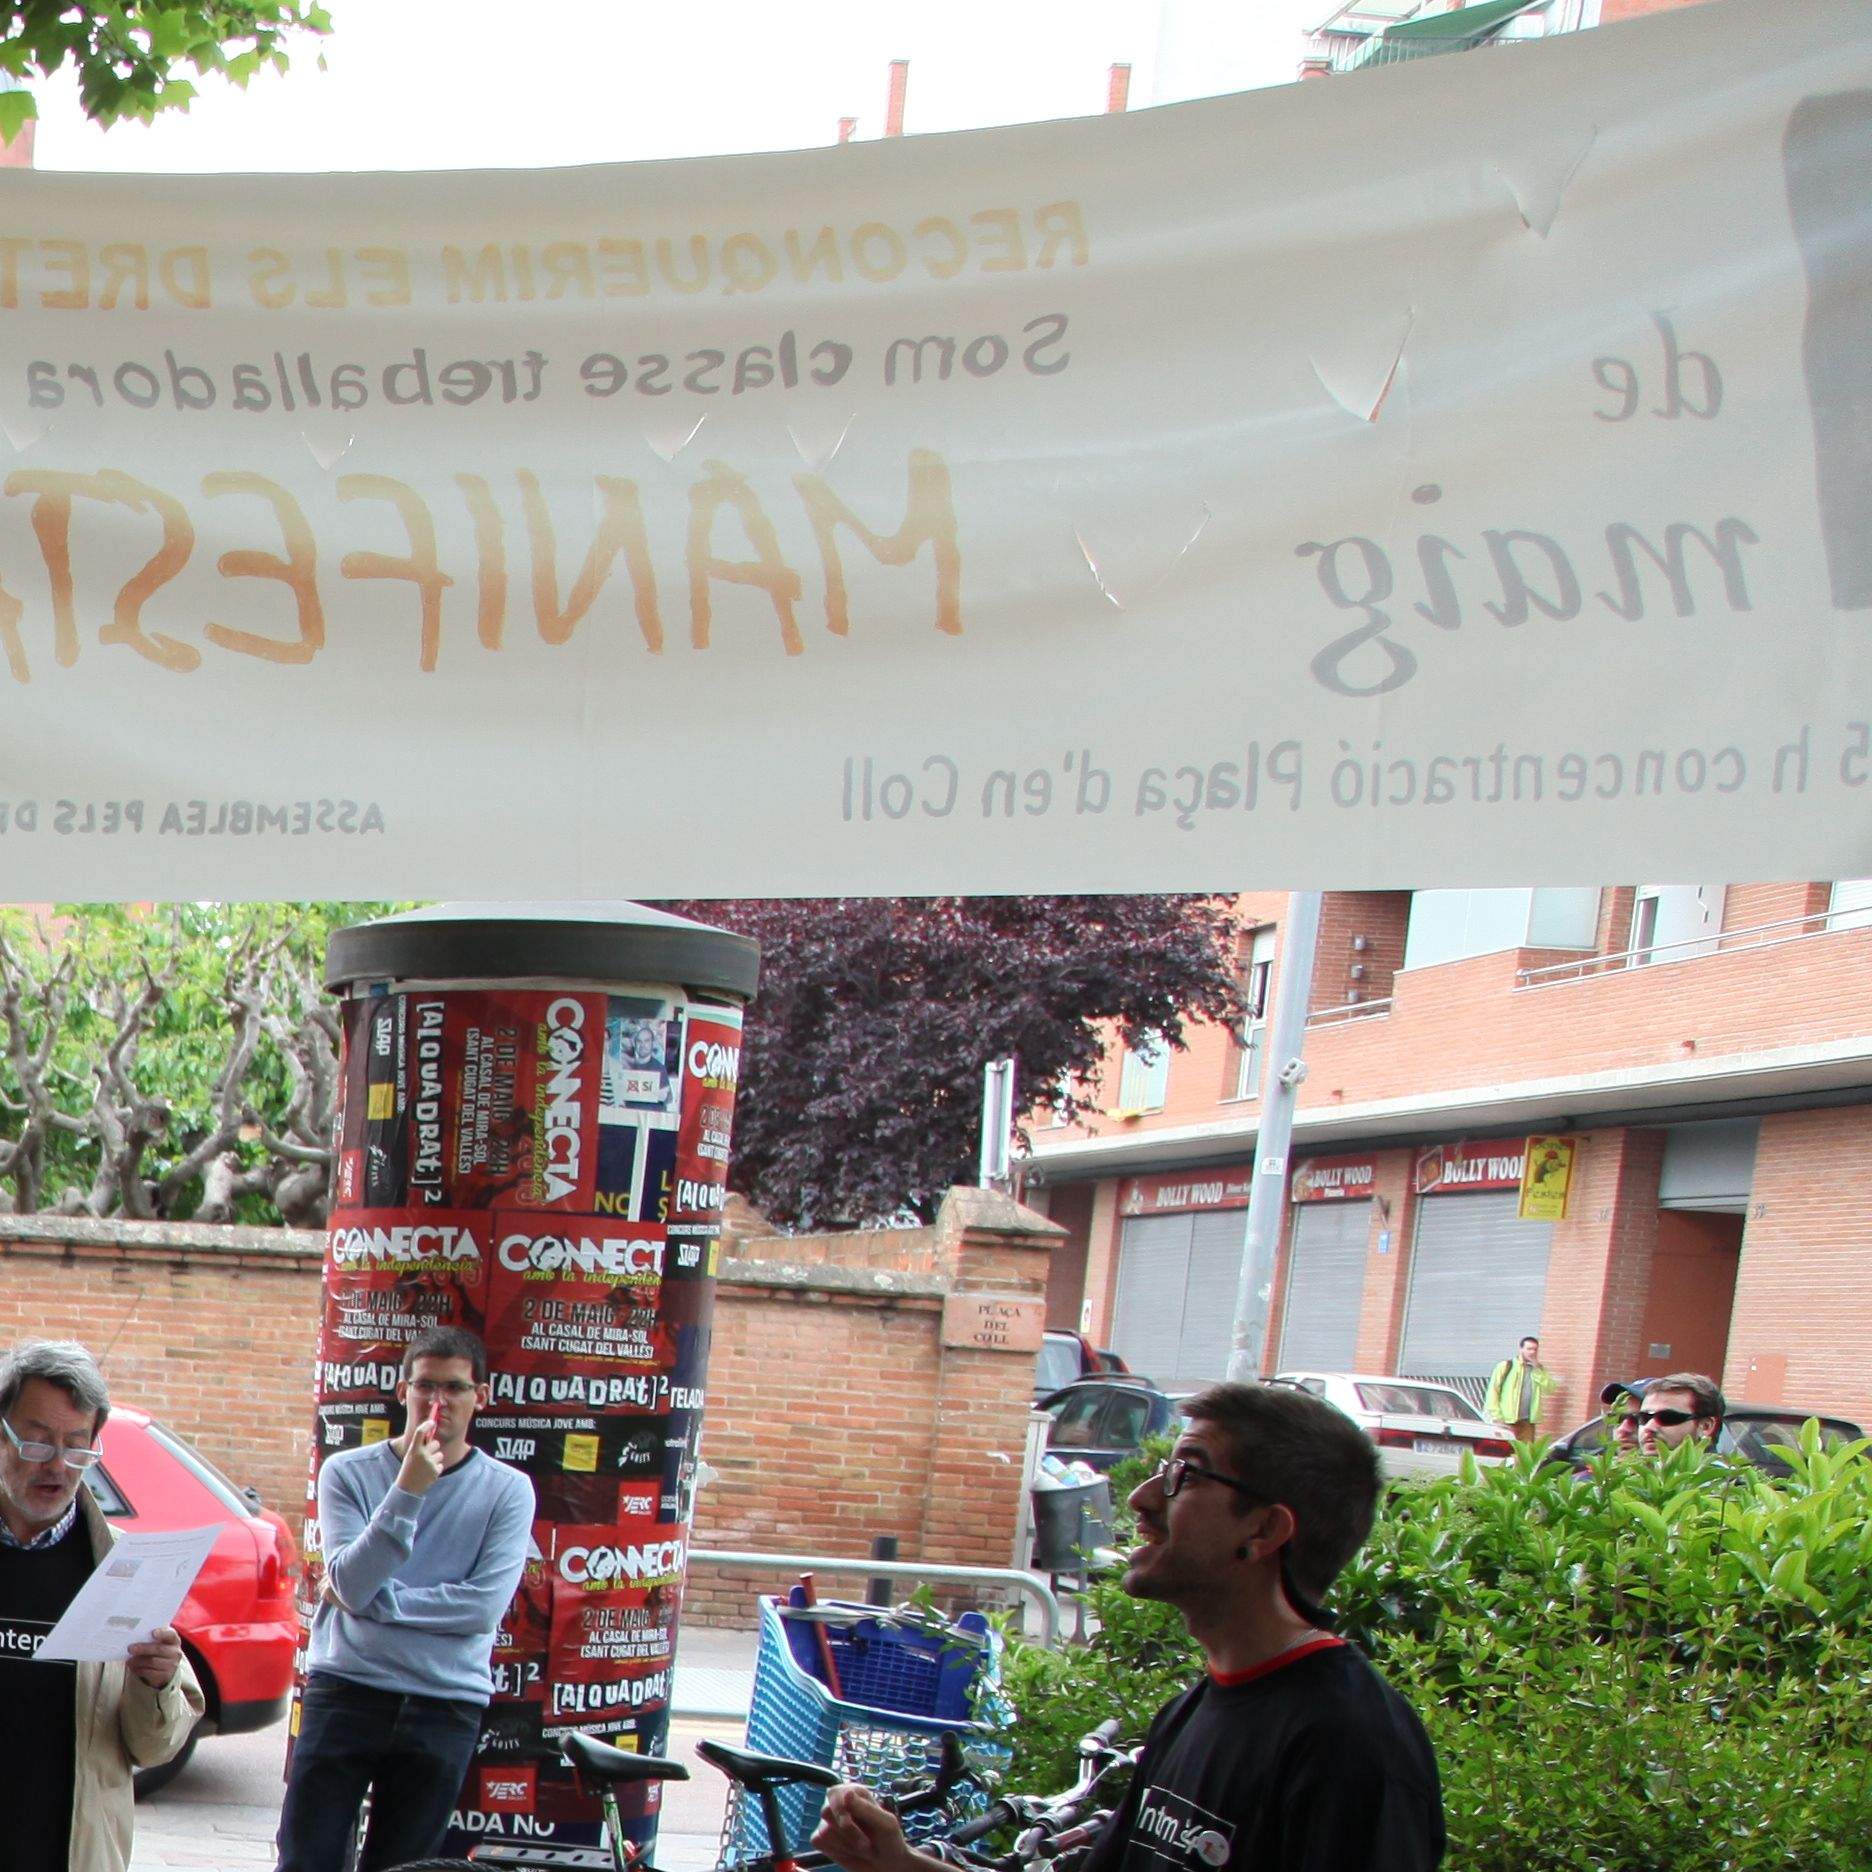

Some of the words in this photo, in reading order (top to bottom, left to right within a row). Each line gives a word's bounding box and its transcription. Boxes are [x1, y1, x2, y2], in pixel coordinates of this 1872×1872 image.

[542, 997, 586, 1204] CONNECTA
[583, 1270, 662, 1290] independen
[541, 1300, 565, 1321] DE
[571, 1302, 615, 1325] MAIG
[531, 1321, 547, 1336] AL
[548, 1322, 584, 1339] CASAL
[586, 1325, 602, 1340] DE
